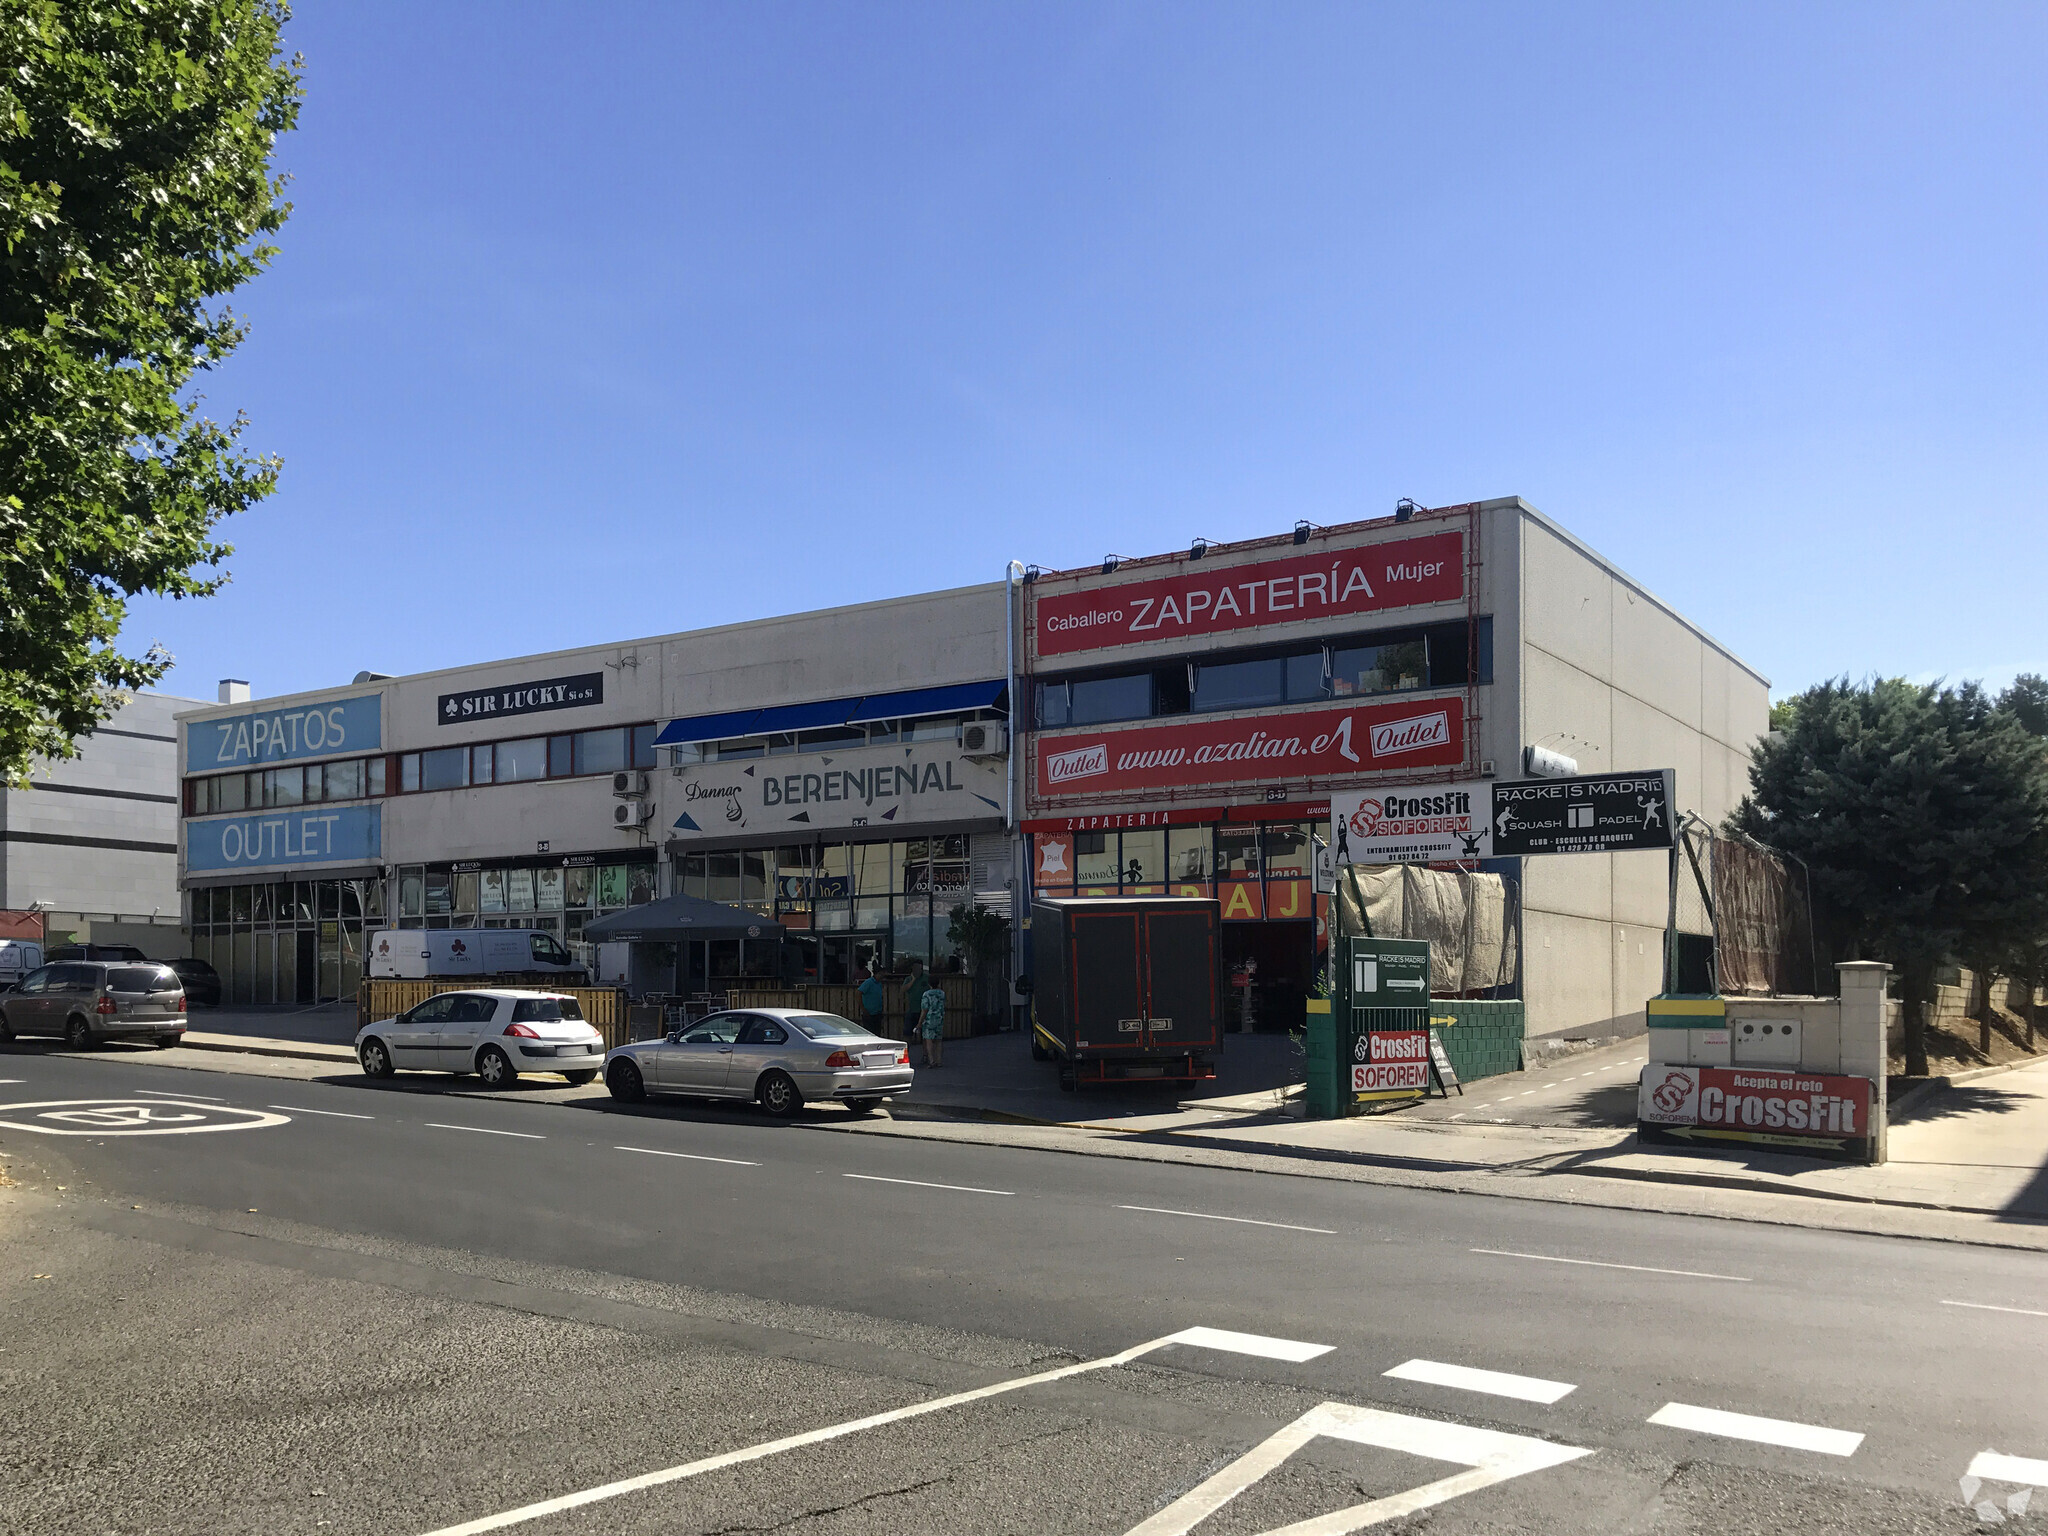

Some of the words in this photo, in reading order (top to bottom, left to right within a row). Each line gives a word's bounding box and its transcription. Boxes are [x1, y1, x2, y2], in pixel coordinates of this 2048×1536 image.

[1046, 608, 1124, 633] Caballero
[1128, 559, 1375, 632] ZAPATERÍA
[1386, 560, 1444, 584] Mujer
[461, 696, 497, 717] SIR
[502, 684, 568, 711] LUCKY
[216, 708, 346, 764] ZAPATOS
[1375, 720, 1442, 748] Outlet
[1051, 752, 1104, 778] Outlet
[763, 761, 964, 806] BERENJENAL
[1588, 781, 1663, 796] MADRID
[1384, 791, 1471, 818] CrossFit
[1067, 812, 1169, 830] ZAPATERÍA
[1377, 816, 1471, 836] SOFOREM
[1509, 820, 1562, 831] SQUASH
[1598, 815, 1642, 825] PADEL
[221, 815, 340, 862] OUTLET
[1367, 845, 1418, 854] ENTRENAMIENTO
[1419, 844, 1452, 852] CROSSFIT
[1529, 838, 1548, 846] CLUB
[1555, 836, 1587, 845] ESCUELA
[1588, 835, 1599, 843] DE
[1600, 833, 1634, 843] RAQUETA
[1046, 854, 1060, 862] Piel
[1371, 1034, 1427, 1059] CrossFit
[1355, 1066, 1427, 1089] SOFOREM
[1734, 1074, 1777, 1090] Acepta
[1781, 1079, 1792, 1090] el
[1796, 1081, 1823, 1091] reto
[1650, 1113, 1696, 1123] SOFOREM
[1701, 1087, 1857, 1133] CrossFit
